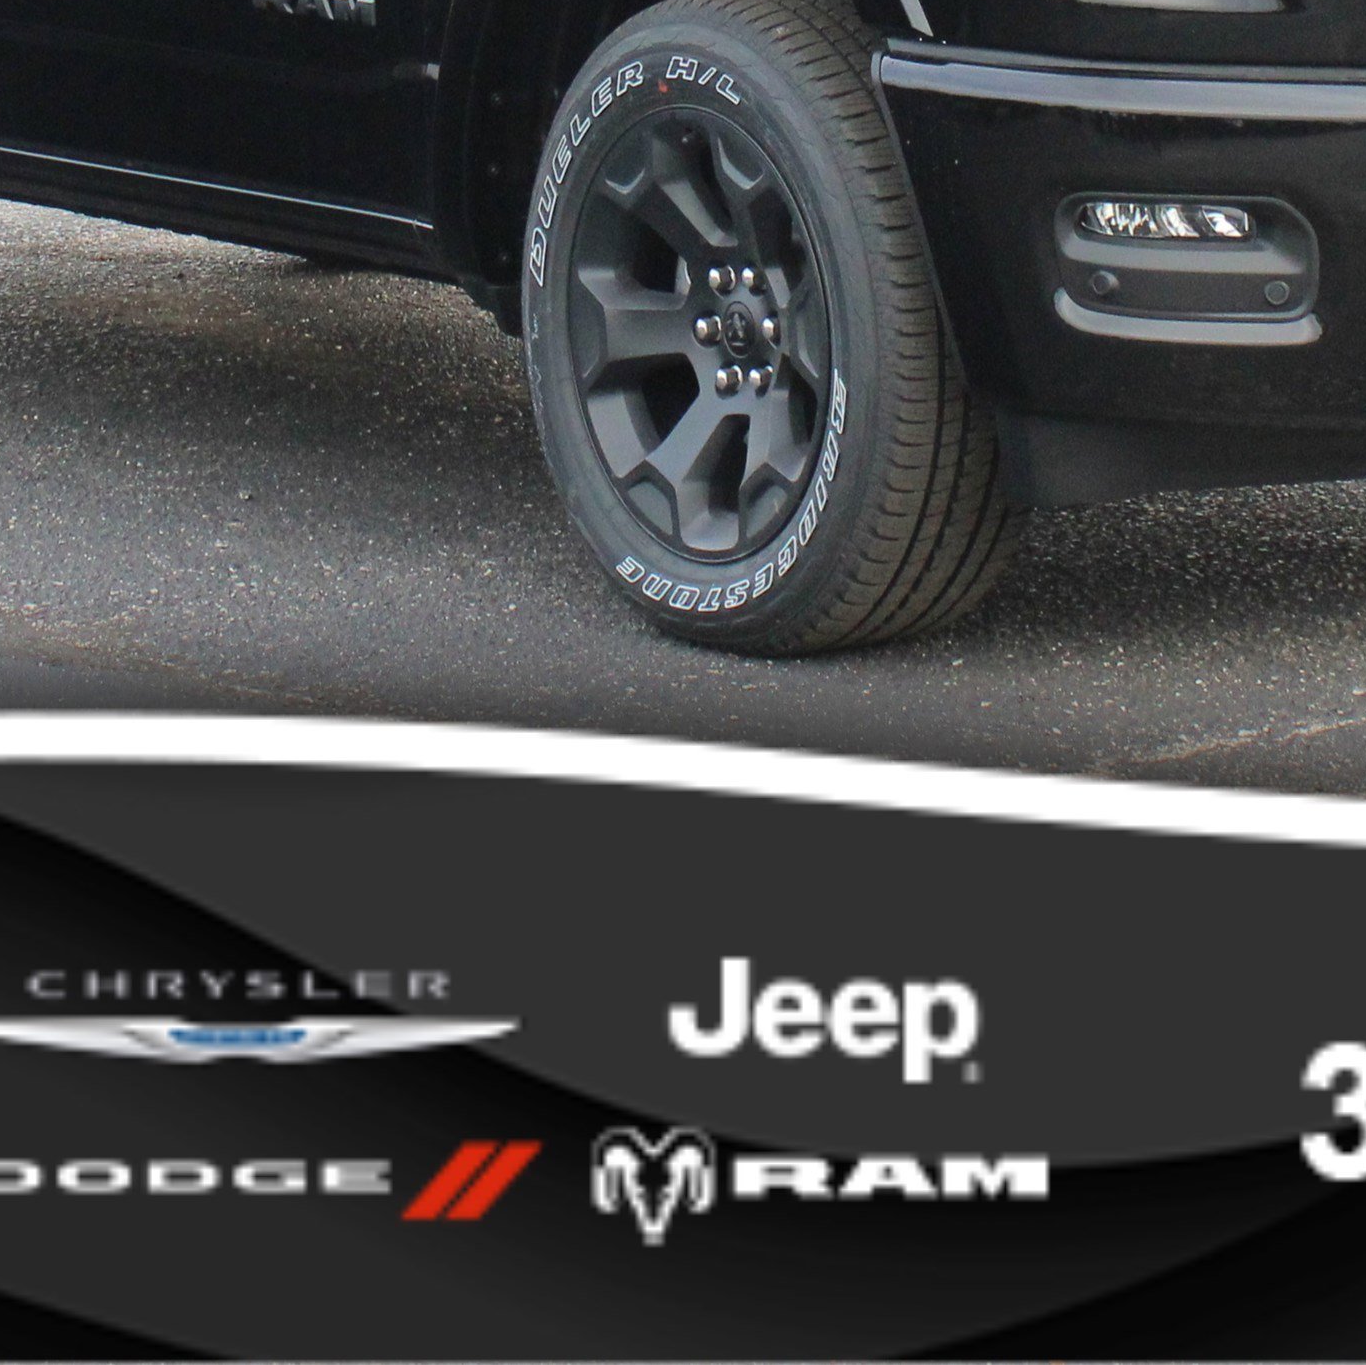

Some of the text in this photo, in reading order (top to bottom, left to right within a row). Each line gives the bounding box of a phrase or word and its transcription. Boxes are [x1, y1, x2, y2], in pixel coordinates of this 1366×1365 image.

[529, 55, 741, 287] DUELER H/L
[615, 368, 847, 613] BRIDGESTONE
